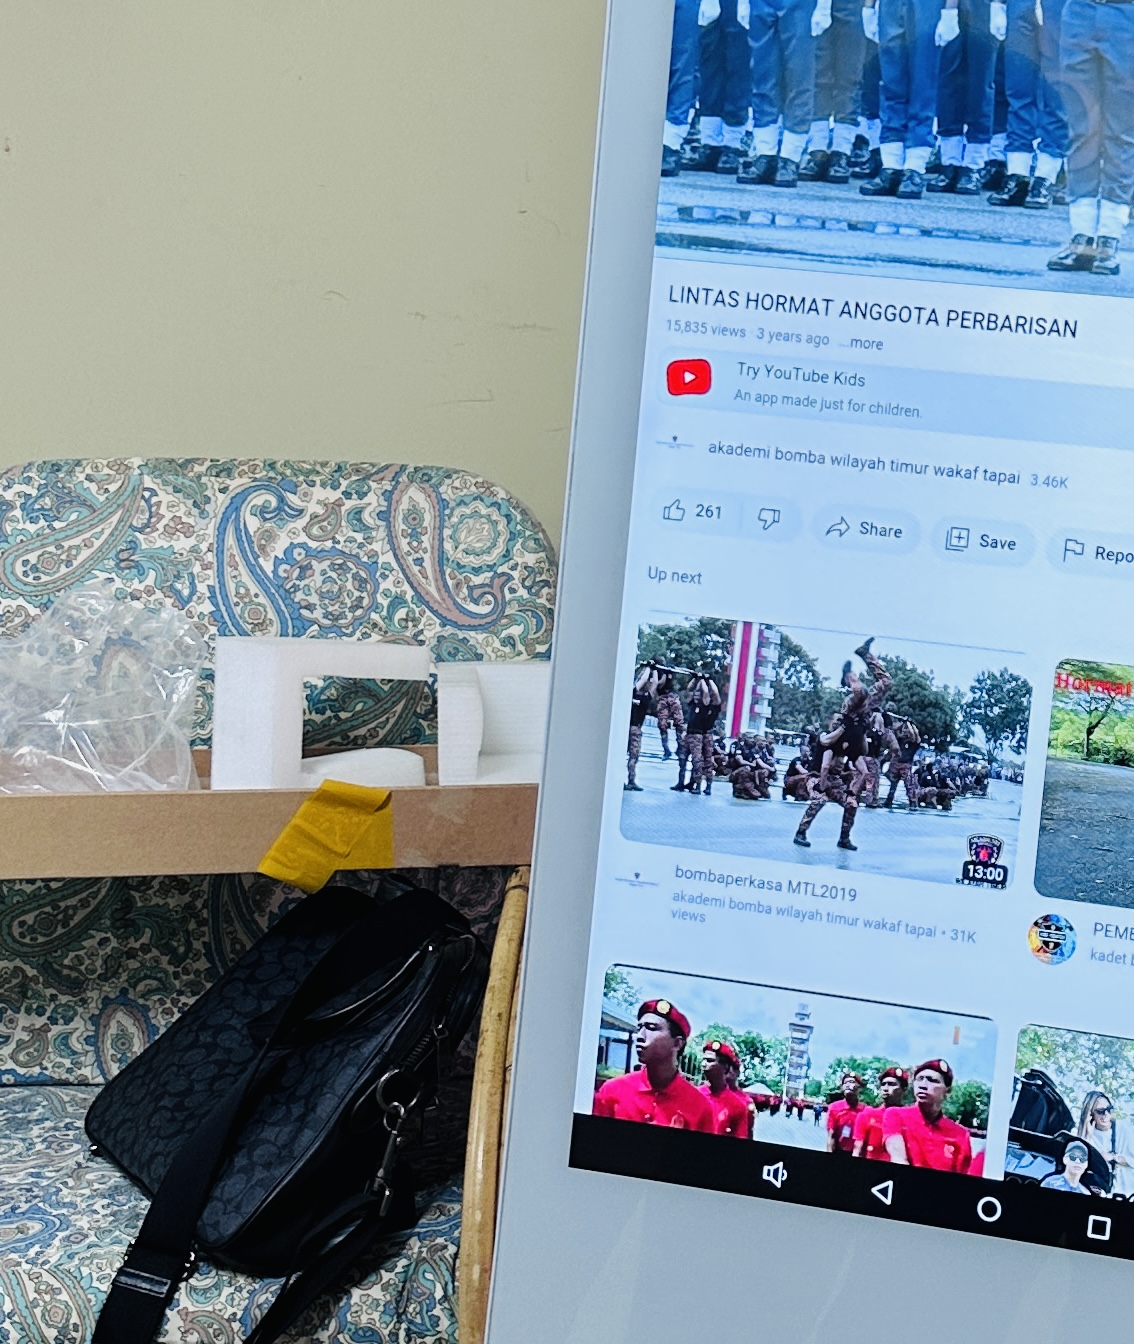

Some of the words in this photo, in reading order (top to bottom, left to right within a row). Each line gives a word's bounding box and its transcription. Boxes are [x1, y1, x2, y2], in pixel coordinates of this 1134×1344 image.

[669, 285, 739, 308] LINTAS
[746, 294, 834, 318] HORMAT
[839, 300, 940, 327] ANGGOTA
[946, 309, 1078, 339] PERBARISAN
[666, 319, 708, 336] 15,835
[711, 323, 746, 339] views
[757, 327, 764, 340] 3
[768, 328, 803, 345] years
[806, 333, 829, 347] ago
[737, 362, 760, 380] Try
[764, 364, 829, 385] YouTube
[834, 371, 866, 388] Kids
[734, 389, 752, 402] An
[754, 393, 778, 408] app
[782, 393, 817, 409] made
[820, 397, 844, 413] just
[848, 398, 866, 413] for
[869, 402, 922, 419] children.
[708, 440, 771, 460] akademi
[775, 446, 826, 465] bomba
[830, 450, 886, 472] wilayah
[890, 458, 929, 476] timur
[933, 463, 979, 482] wakaf
[983, 468, 1021, 486] tapai
[1031, 473, 1069, 490] 3.46K
[696, 505, 722, 520] 261
[859, 522, 902, 539] Share
[979, 535, 1016, 551] Save
[648, 567, 668, 584] Up
[671, 570, 702, 586] next
[675, 865, 783, 893] bombaperkasa
[787, 880, 857, 902] MTL2019
[968, 865, 1003, 881] 13:00
[671, 908, 706, 923] views
[673, 890, 726, 908] akademi
[729, 897, 772, 914] bomba
[775, 903, 823, 922] wilayah
[826, 910, 860, 927] timur
[863, 916, 901, 932] wakaf
[905, 923, 937, 938] tapai
[951, 928, 977, 944] 31K
[1090, 948, 1127, 966] kadet
